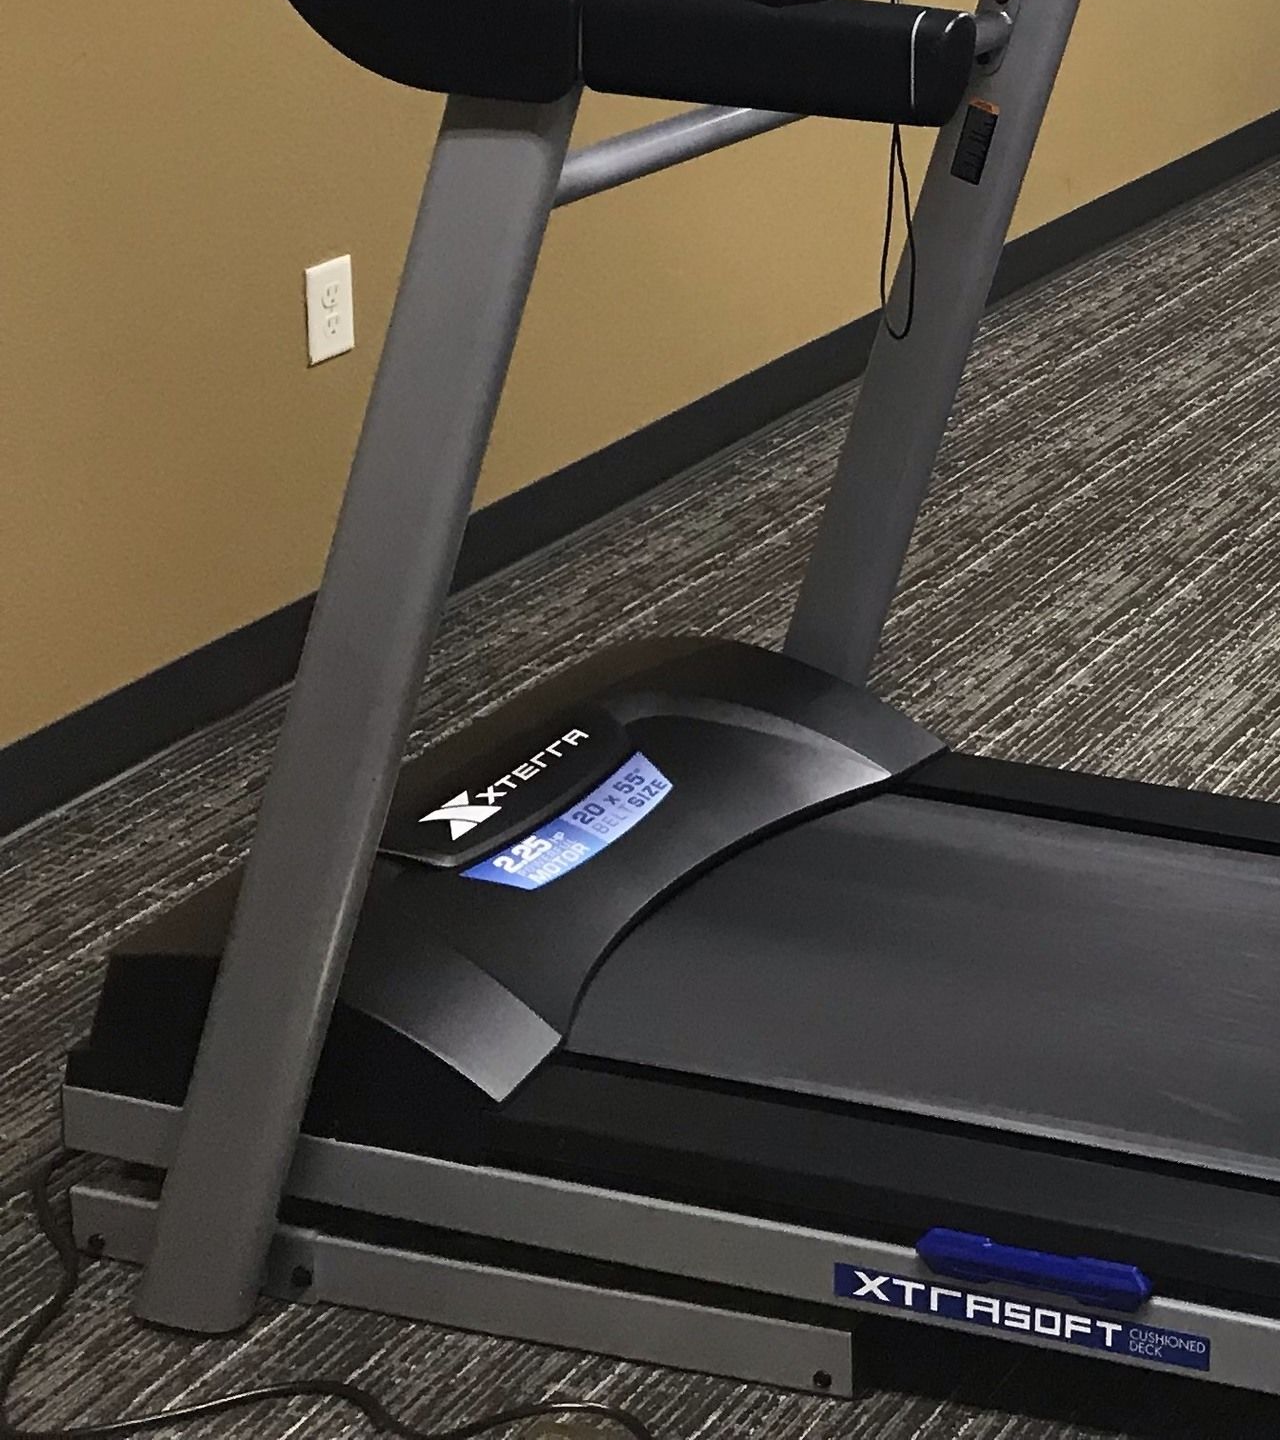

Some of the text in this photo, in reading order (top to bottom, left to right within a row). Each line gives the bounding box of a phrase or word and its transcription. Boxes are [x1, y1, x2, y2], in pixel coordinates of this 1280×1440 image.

[475, 728, 590, 805] XTERRA
[627, 778, 668, 808] SIZE
[572, 803, 606, 825] 20
[528, 842, 591, 885] MOTOR
[852, 1269, 1122, 1348] XTRASOFT
[1129, 1328, 1206, 1355] CUSHIONED
[1129, 1340, 1163, 1358] DECK
